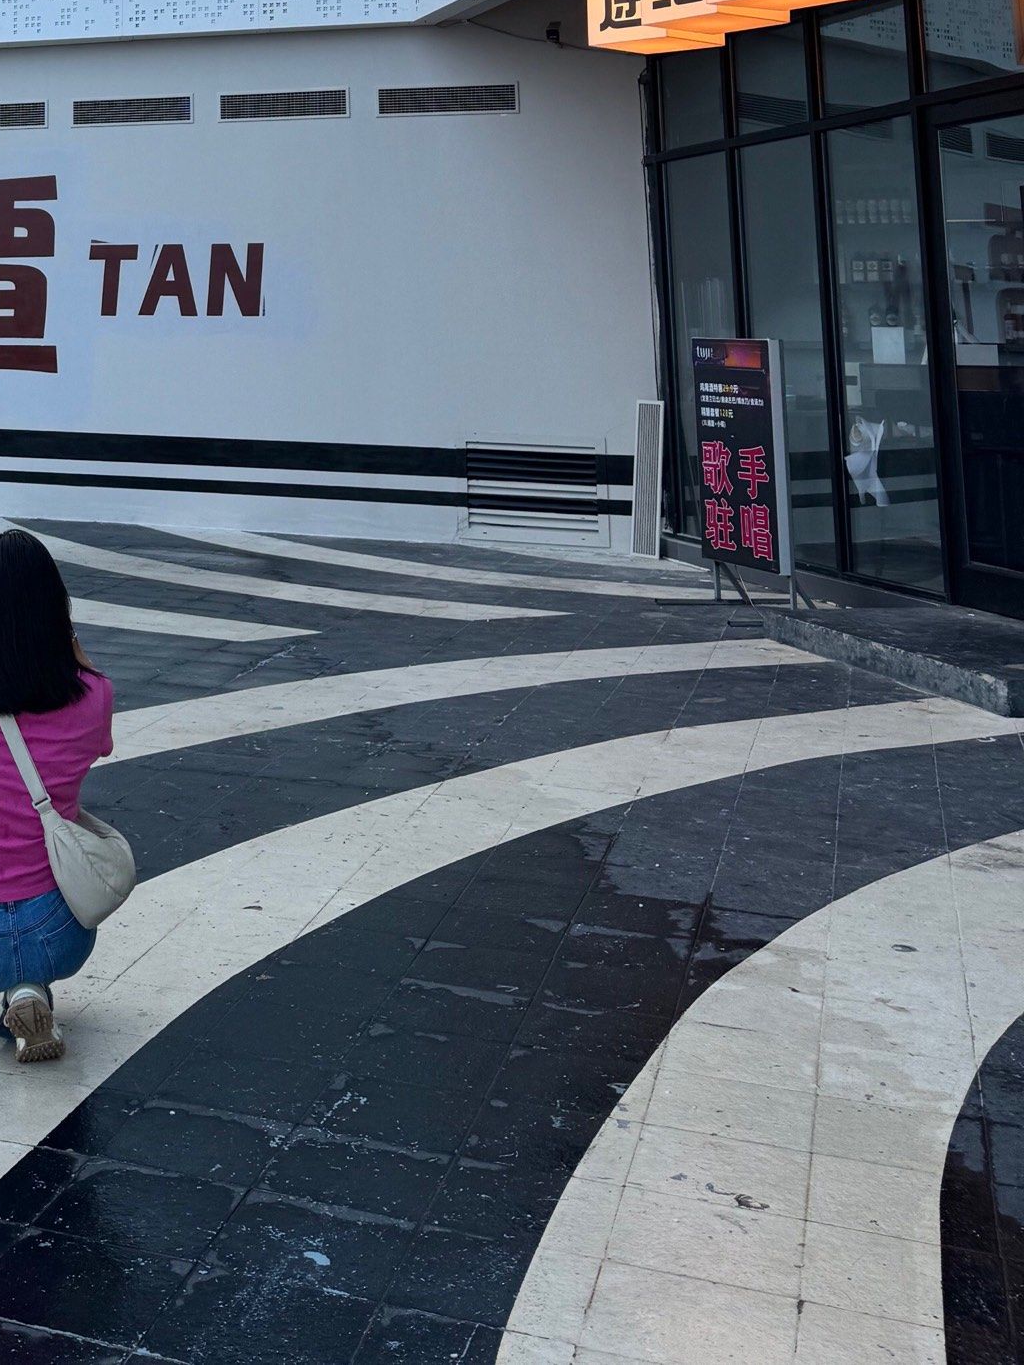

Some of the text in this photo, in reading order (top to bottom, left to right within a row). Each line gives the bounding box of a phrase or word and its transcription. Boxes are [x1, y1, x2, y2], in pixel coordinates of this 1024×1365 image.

[90, 242, 264, 317] TAN
[702, 441, 770, 500] 歌手
[705, 498, 774, 561] 驻唱
